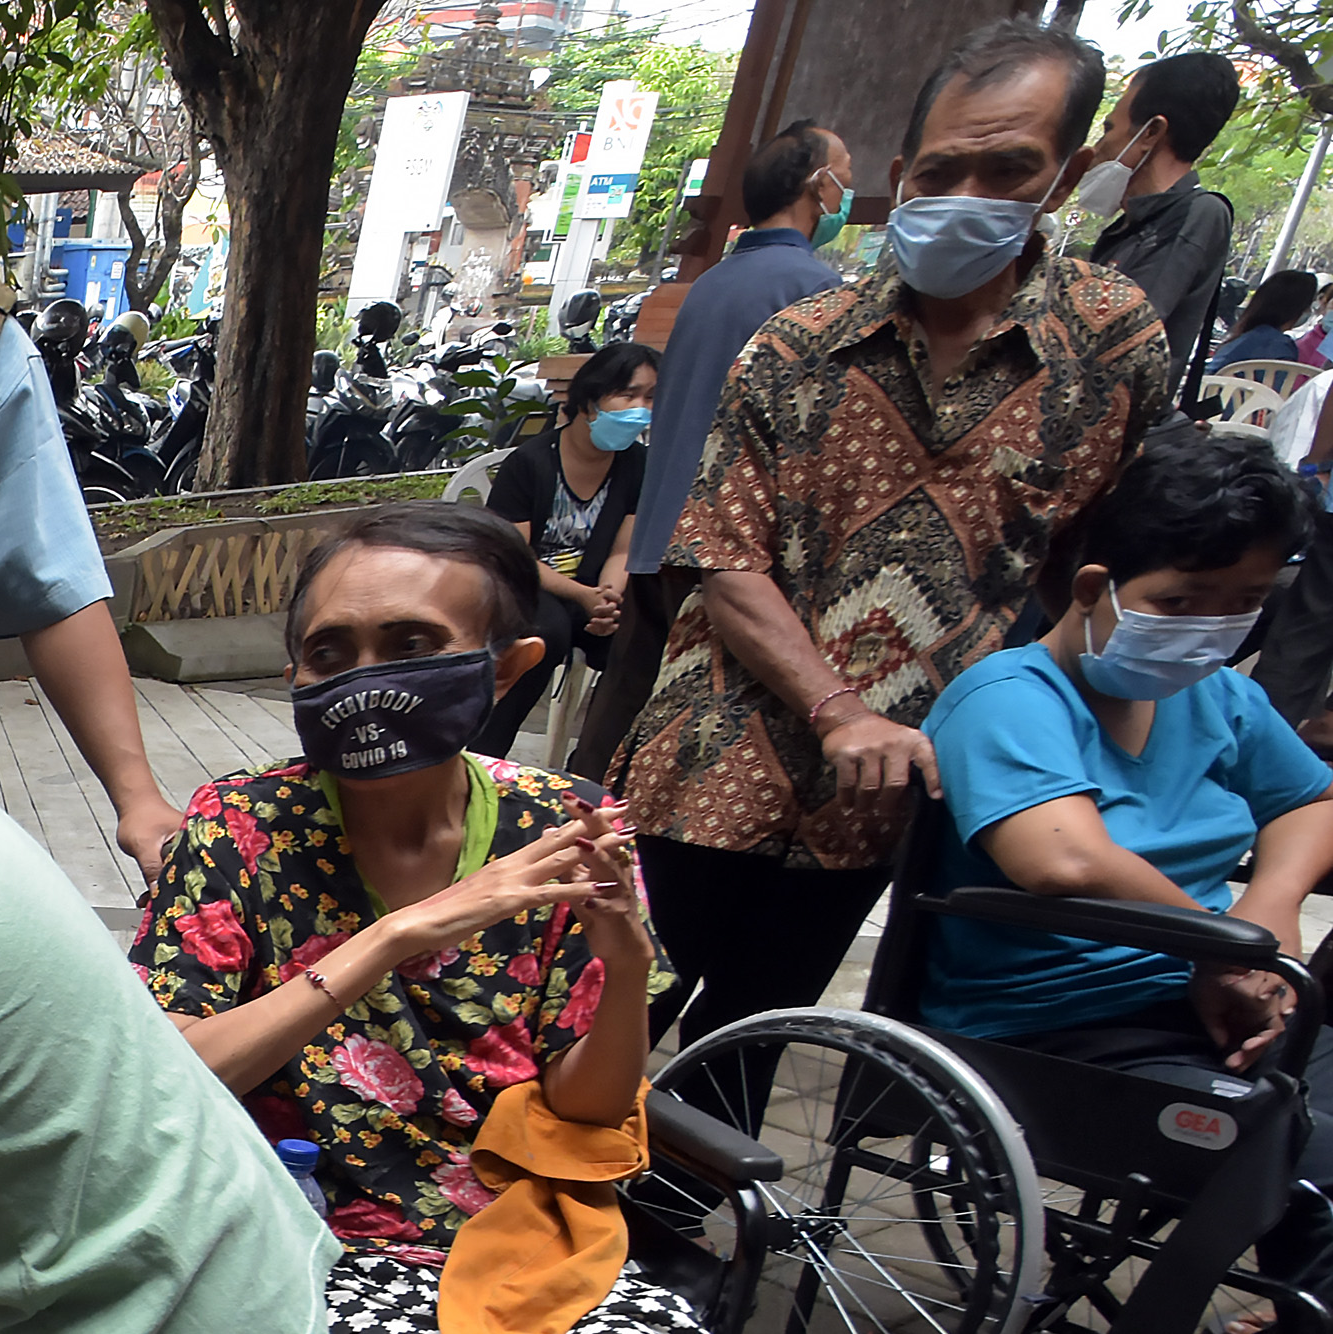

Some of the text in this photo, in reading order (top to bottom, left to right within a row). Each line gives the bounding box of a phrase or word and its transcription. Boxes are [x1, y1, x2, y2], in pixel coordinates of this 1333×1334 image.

[590, 176, 614, 187] ATM
[321, 689, 424, 730] EVERYBODY
[341, 740, 408, 769] COVID 19
[1175, 1110, 1221, 1136] GEA
